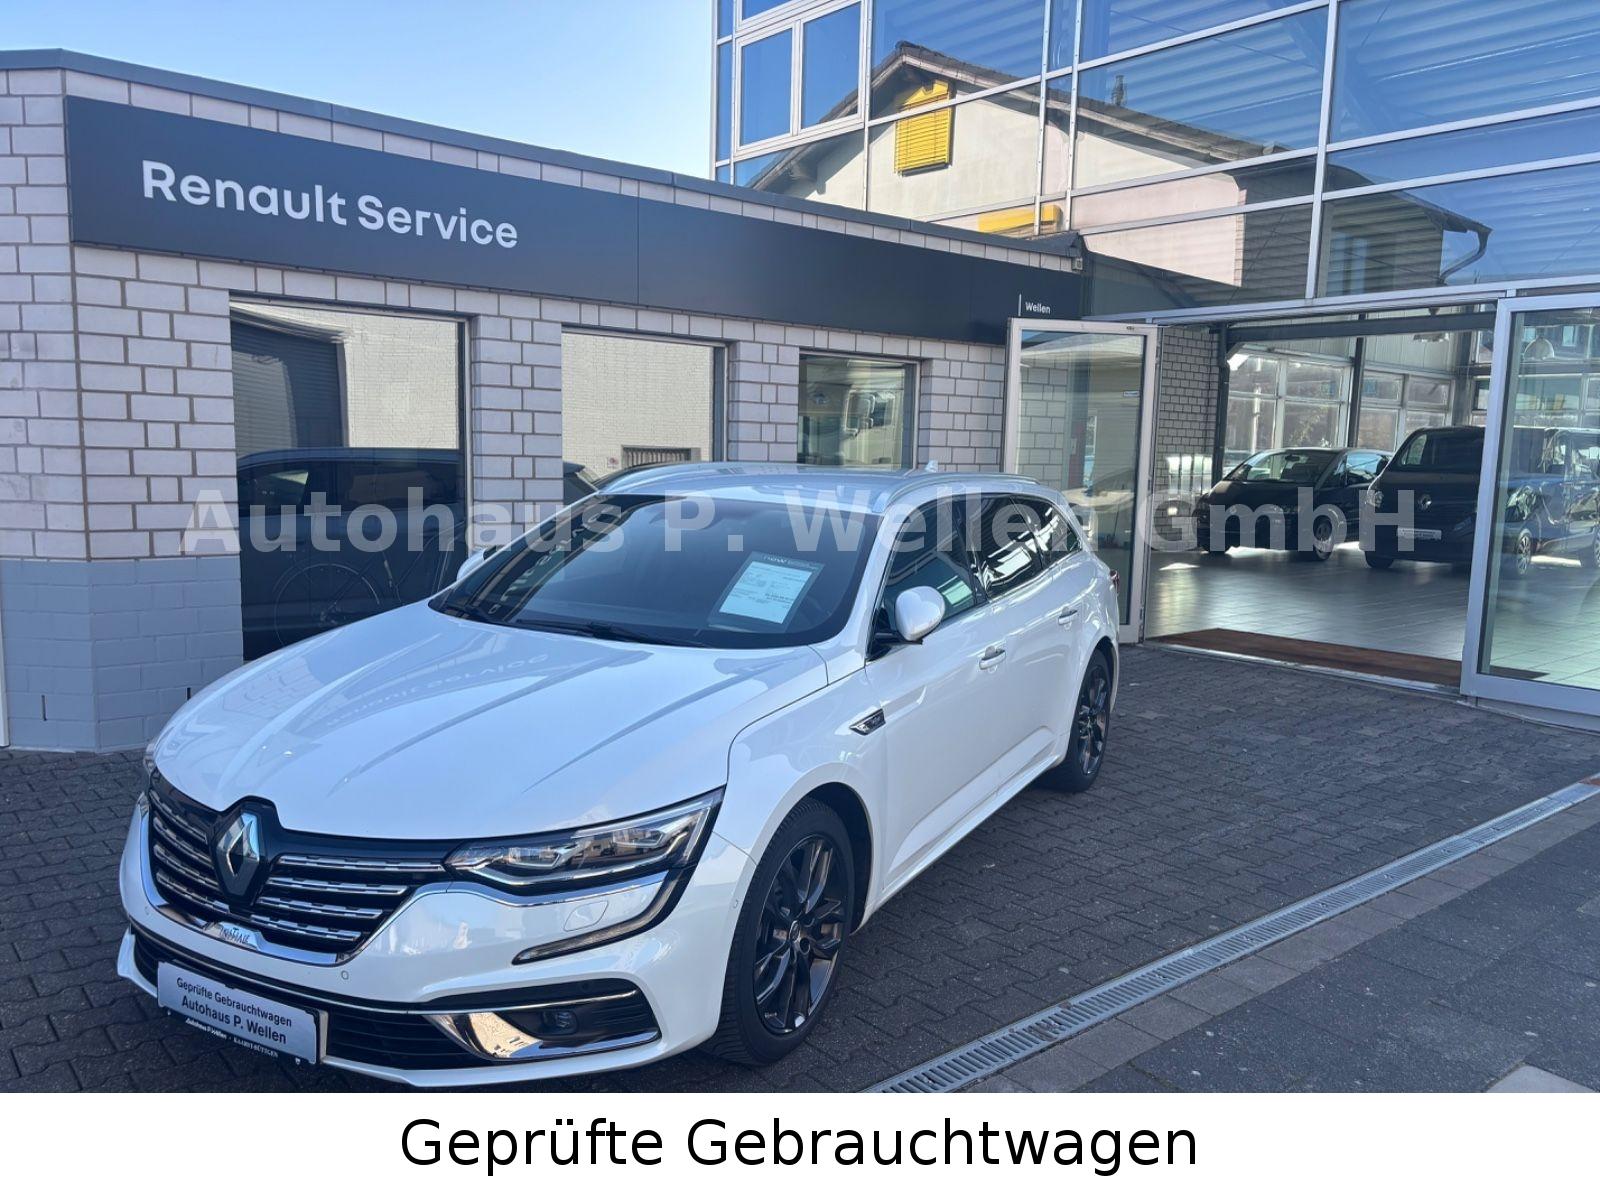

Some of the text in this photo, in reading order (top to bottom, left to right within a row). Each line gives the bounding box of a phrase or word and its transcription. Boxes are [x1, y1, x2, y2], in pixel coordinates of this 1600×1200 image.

[142, 160, 518, 249] Renault Service
[1025, 301, 1051, 314] Wellen
[176, 977, 292, 1027] Geprüfte Gebrauchtwagen
[182, 995, 231, 1024] Autohaus
[233, 1014, 244, 1030] P.
[247, 1019, 287, 1044] Wellen
